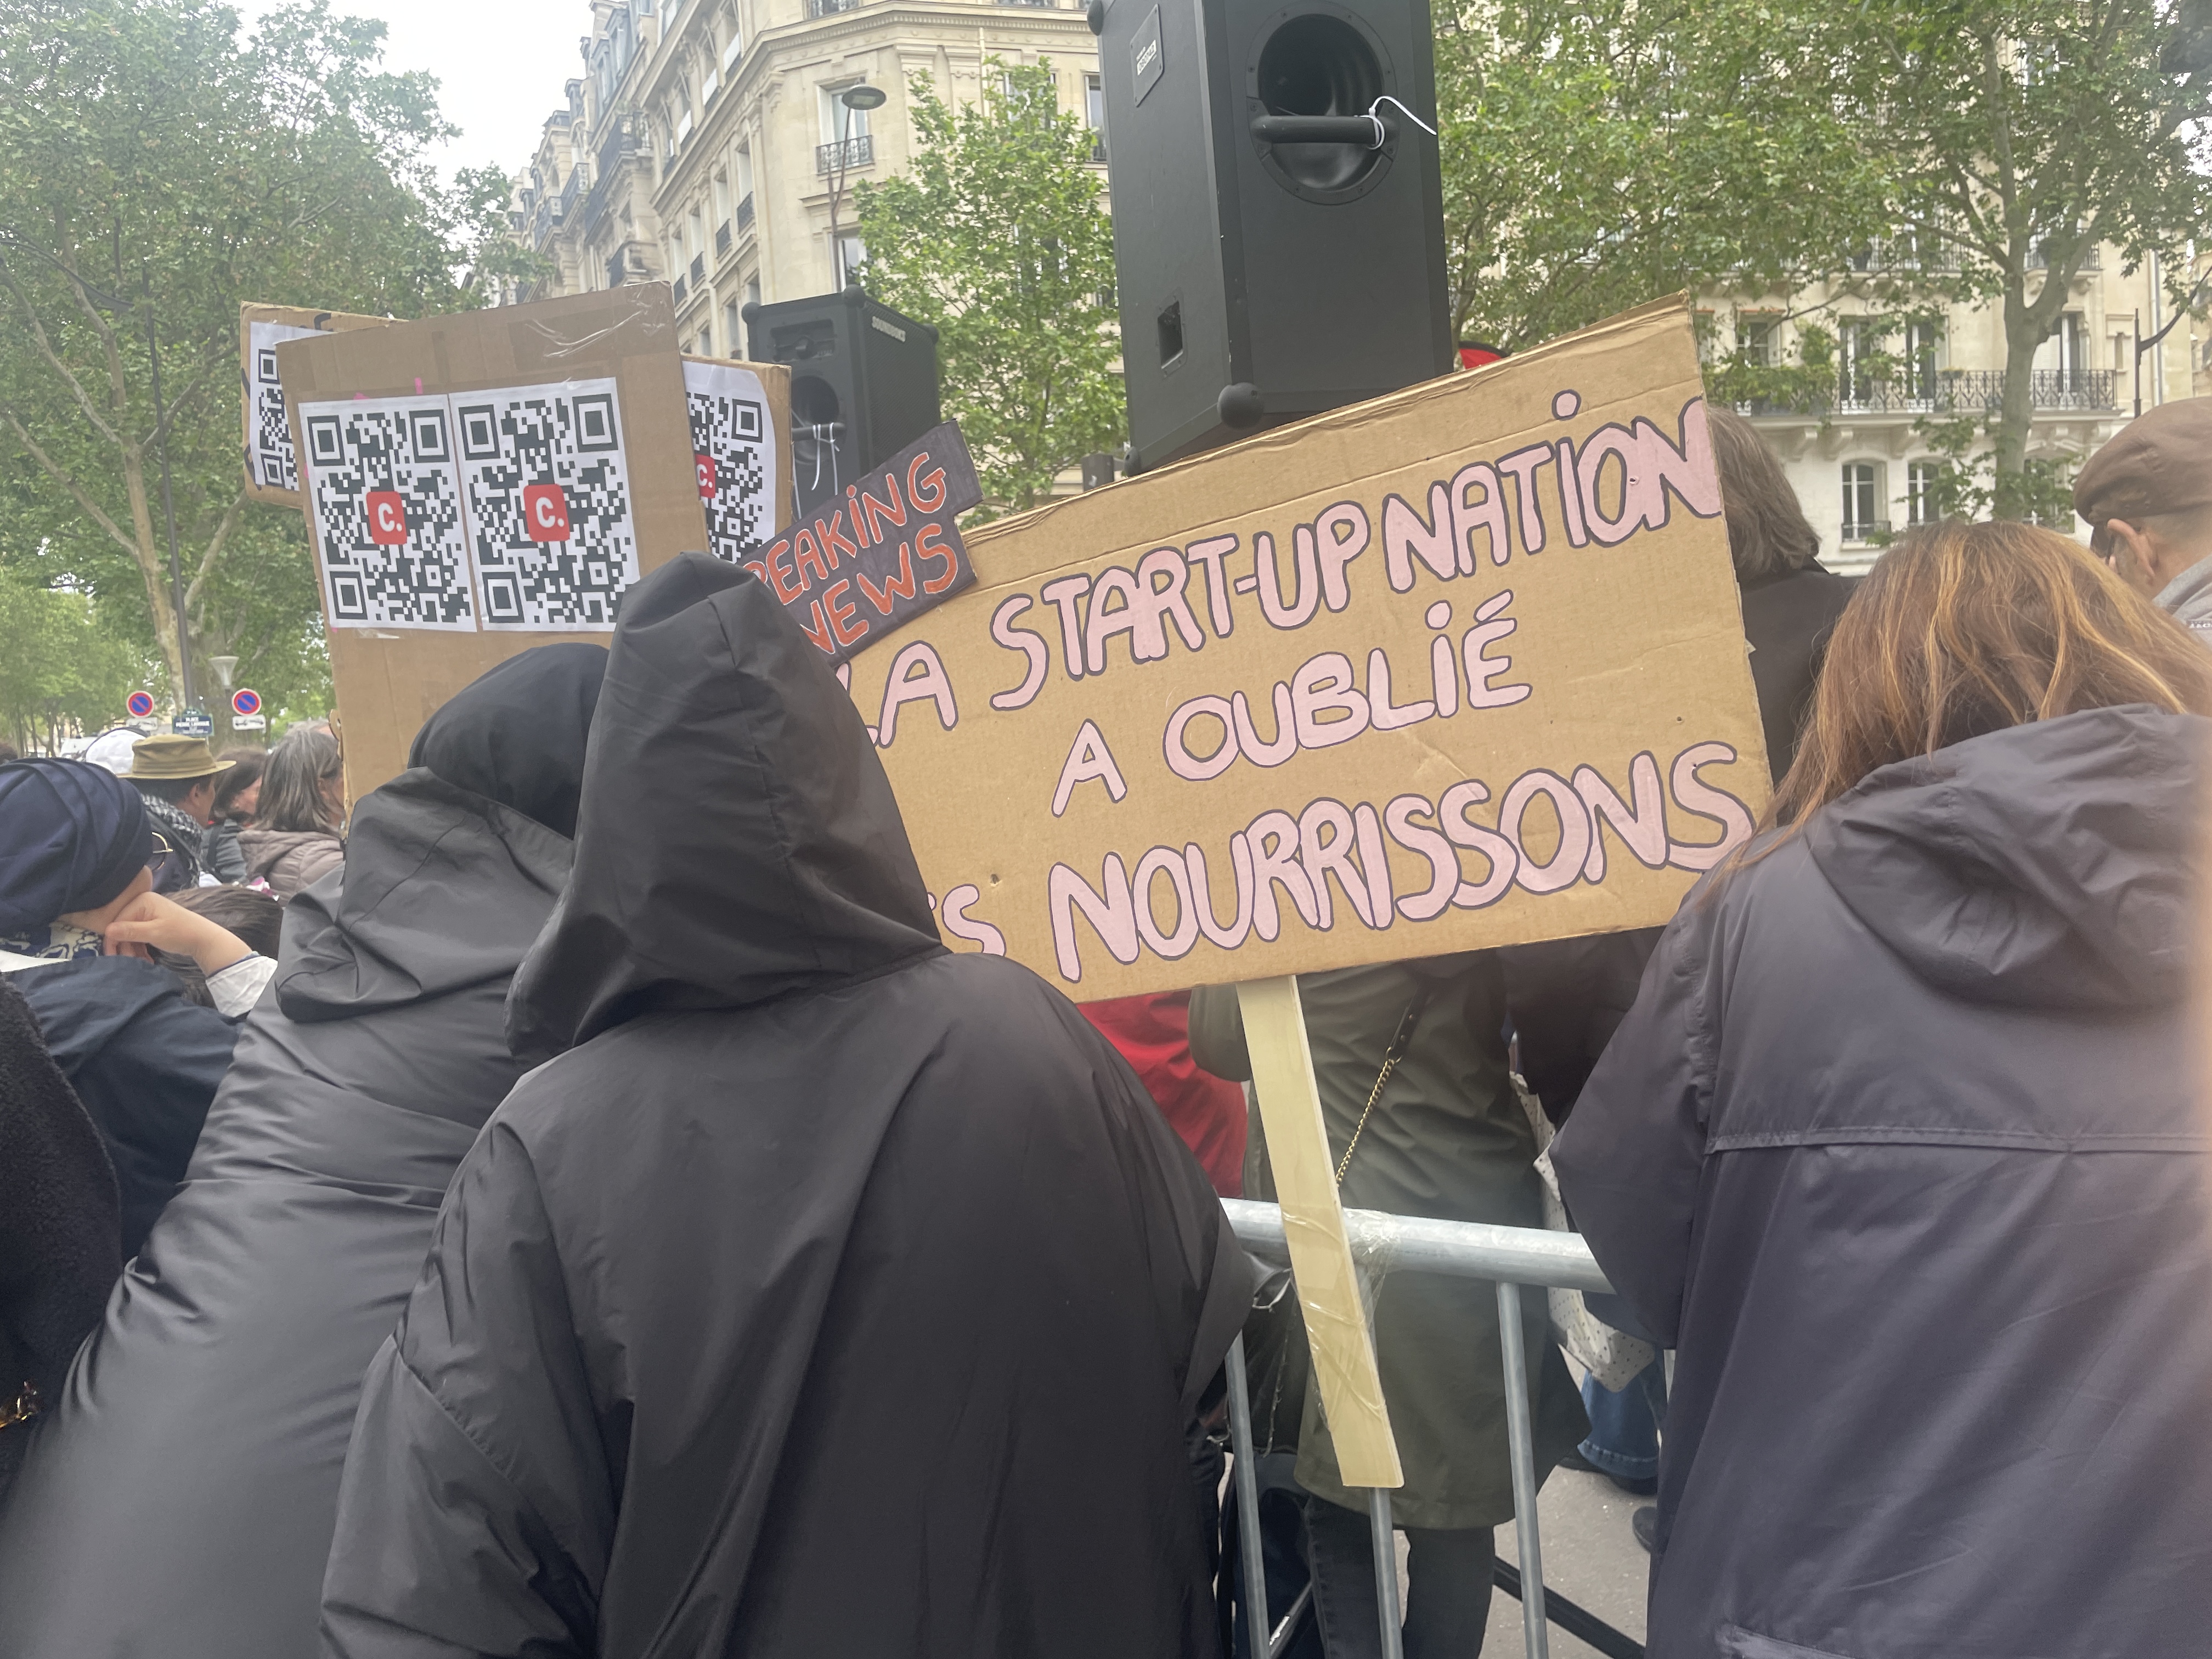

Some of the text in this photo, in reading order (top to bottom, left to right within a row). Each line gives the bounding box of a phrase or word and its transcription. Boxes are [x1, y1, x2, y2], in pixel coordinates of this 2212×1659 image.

[377, 503, 403, 532] C.
[535, 496, 565, 528] C.
[990, 502, 1371, 711] START-UP
[1051, 718, 1127, 817] A
[1049, 741, 1757, 983] NOURRISSONS
